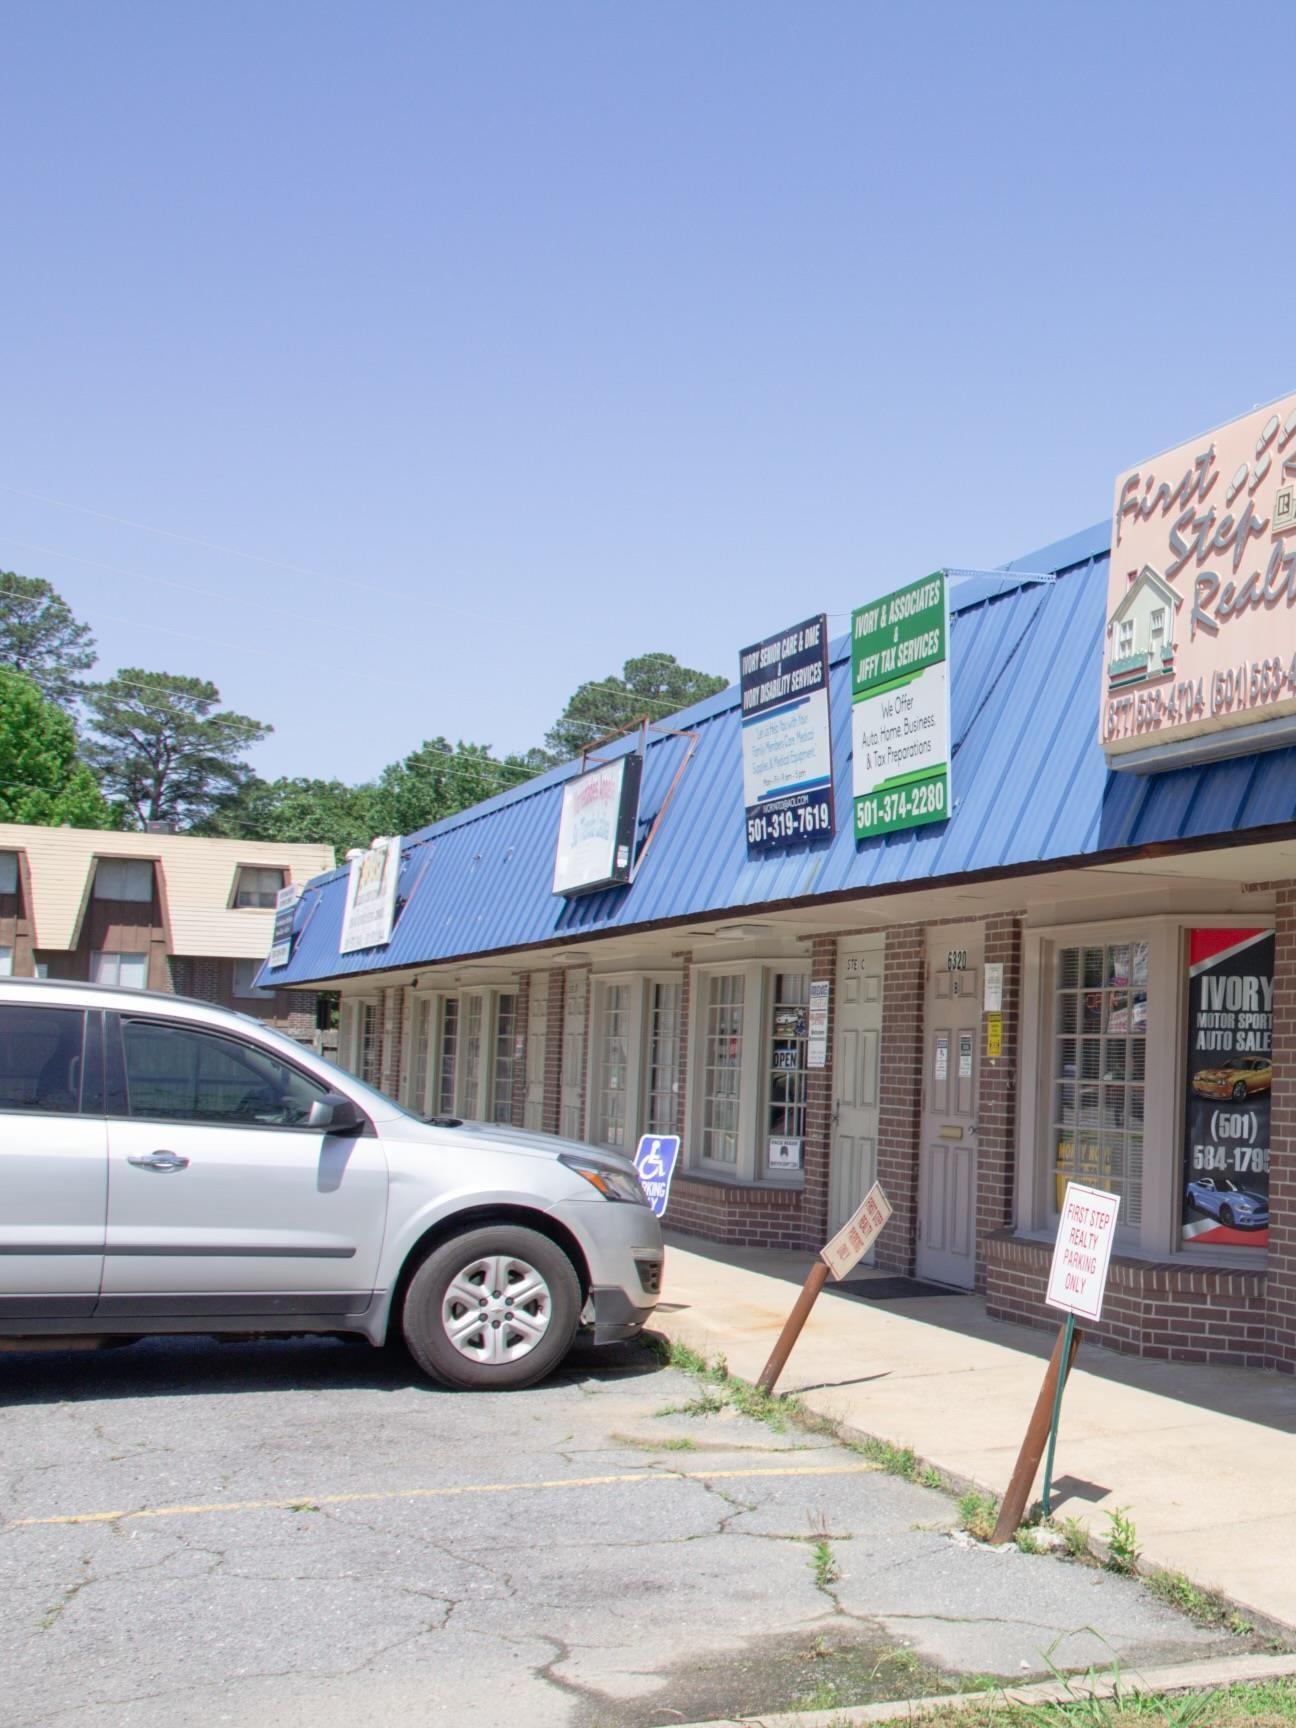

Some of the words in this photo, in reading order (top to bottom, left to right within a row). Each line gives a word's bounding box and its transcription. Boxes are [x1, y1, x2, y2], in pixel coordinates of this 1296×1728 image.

[1116, 443, 1219, 545] First
[1165, 499, 1270, 572] Step
[855, 607, 879, 639] IVORY
[880, 604, 887, 628] &
[888, 580, 940, 624] ASSOCIATES
[893, 626, 899, 643] &
[743, 651, 760, 676] IVORY
[782, 633, 798, 659] CARE
[857, 653, 880, 683] JIFFY
[881, 646, 897, 673] TAX
[897, 628, 940, 667] SERVICES
[791, 660, 822, 692] SERVICES
[881, 702, 893, 718] We
[895, 694, 914, 714] Offer
[873, 750, 886, 767] Tax
[887, 739, 932, 768] Preparations
[857, 782, 944, 829] 501-374-2280
[748, 803, 829, 843] 501-319-7619
[847, 958, 858, 970] STE
[947, 950, 967, 970] 6320
[1200, 975, 1273, 1011] IVORY
[1196, 1012, 1235, 1029] MOTOR
[1196, 1030, 1233, 1051] AUTO
[773, 1052, 796, 1067] OPEN
[1210, 1110, 1258, 1144] (501)
[641, 1181, 666, 1197] RKING
[1067, 1203, 1089, 1224] FIRST
[1090, 1210, 1110, 1230] STEP
[1069, 1227, 1099, 1249] REALTY
[1063, 1249, 1097, 1274] PARKING
[1065, 1273, 1086, 1294] ONLY
